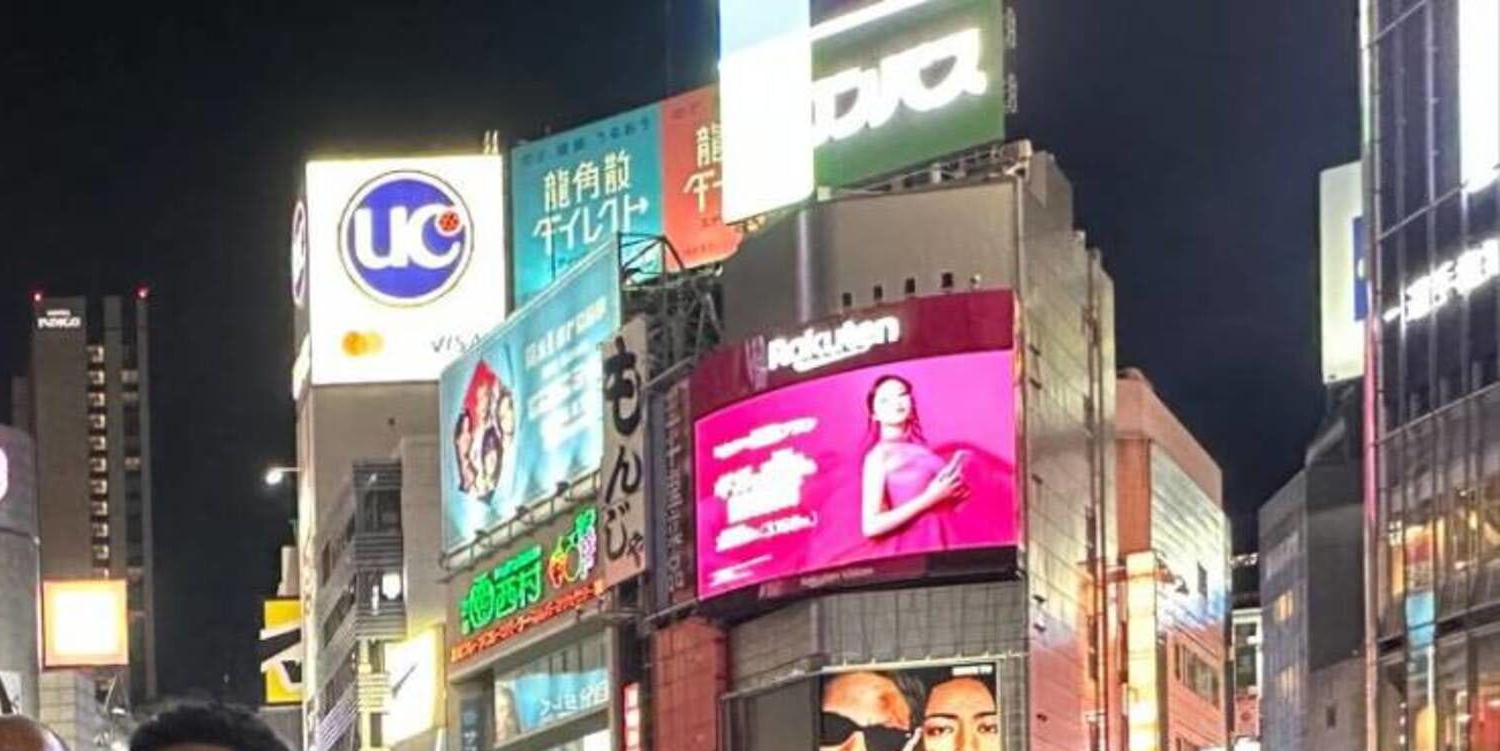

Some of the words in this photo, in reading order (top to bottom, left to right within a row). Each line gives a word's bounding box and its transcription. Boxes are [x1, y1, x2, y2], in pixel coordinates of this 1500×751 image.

[543, 149, 631, 213] 龍角散
[768, 315, 901, 371] Rakuten
[604, 335, 644, 568] もんじゃ
